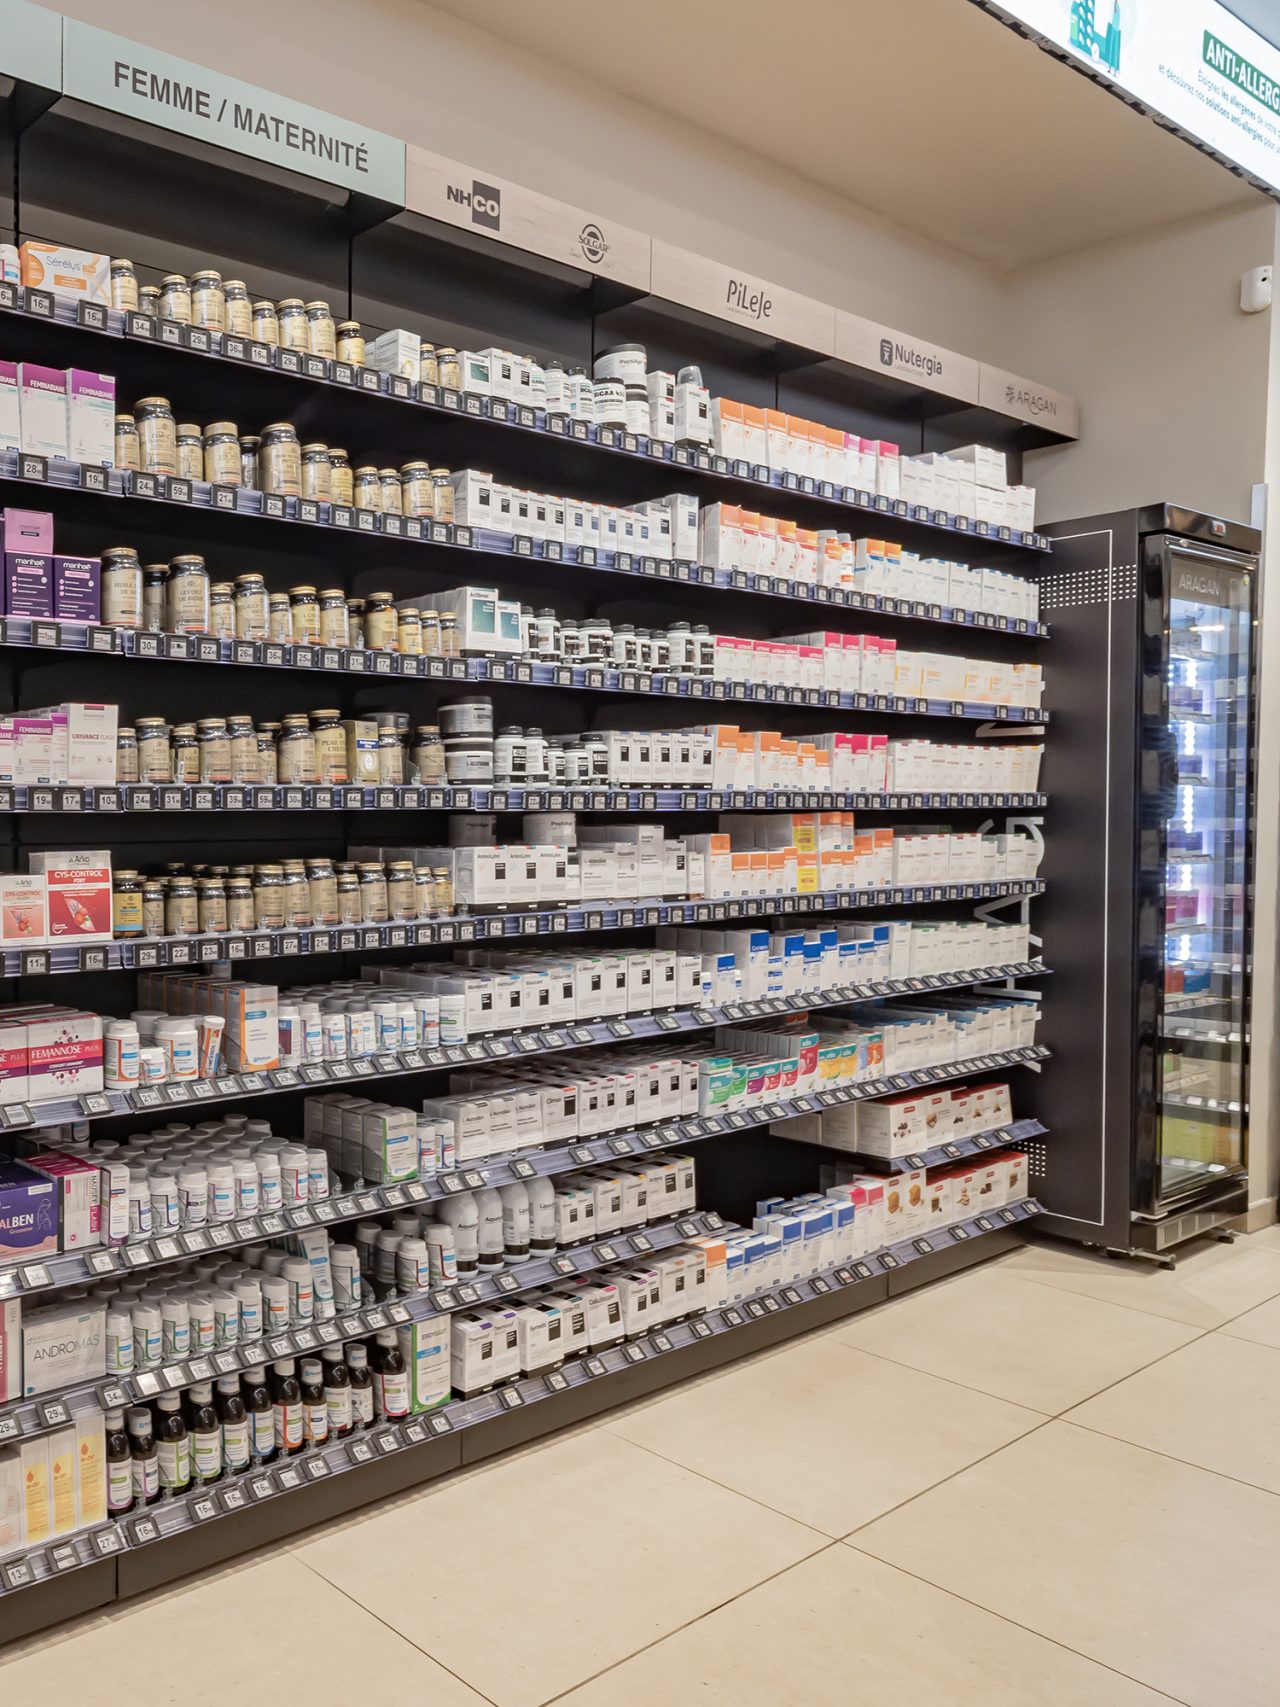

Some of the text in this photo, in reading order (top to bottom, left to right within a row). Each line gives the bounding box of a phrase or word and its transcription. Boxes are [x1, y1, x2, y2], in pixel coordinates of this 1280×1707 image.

[1206, 38, 1280, 115] ANTI-ALLERG
[113, 60, 370, 173] FEMME / MATERNITÉ
[447, 185, 500, 217] NHCO
[578, 235, 608, 253] SOLGAR
[46, 254, 81, 272] Sérélys
[727, 279, 772, 320] PiLeJe
[894, 344, 943, 376] Nutergia
[30, 378, 66, 395] FEMINABIANE
[79, 386, 114, 400] FEMINABIANE
[1016, 389, 1057, 416] ARAGAN
[19, 726, 52, 735] FEMINABIANE
[75, 856, 90, 864] Arko
[54, 870, 103, 879] CYS-CONTROL
[5, 890, 41, 898] CYS-CONTROL
[10, 1051, 25, 1060] PLUS
[31, 1044, 99, 1059] FEMANNOSE PLUS
[33, 1335, 99, 1362] ANDROMAS
